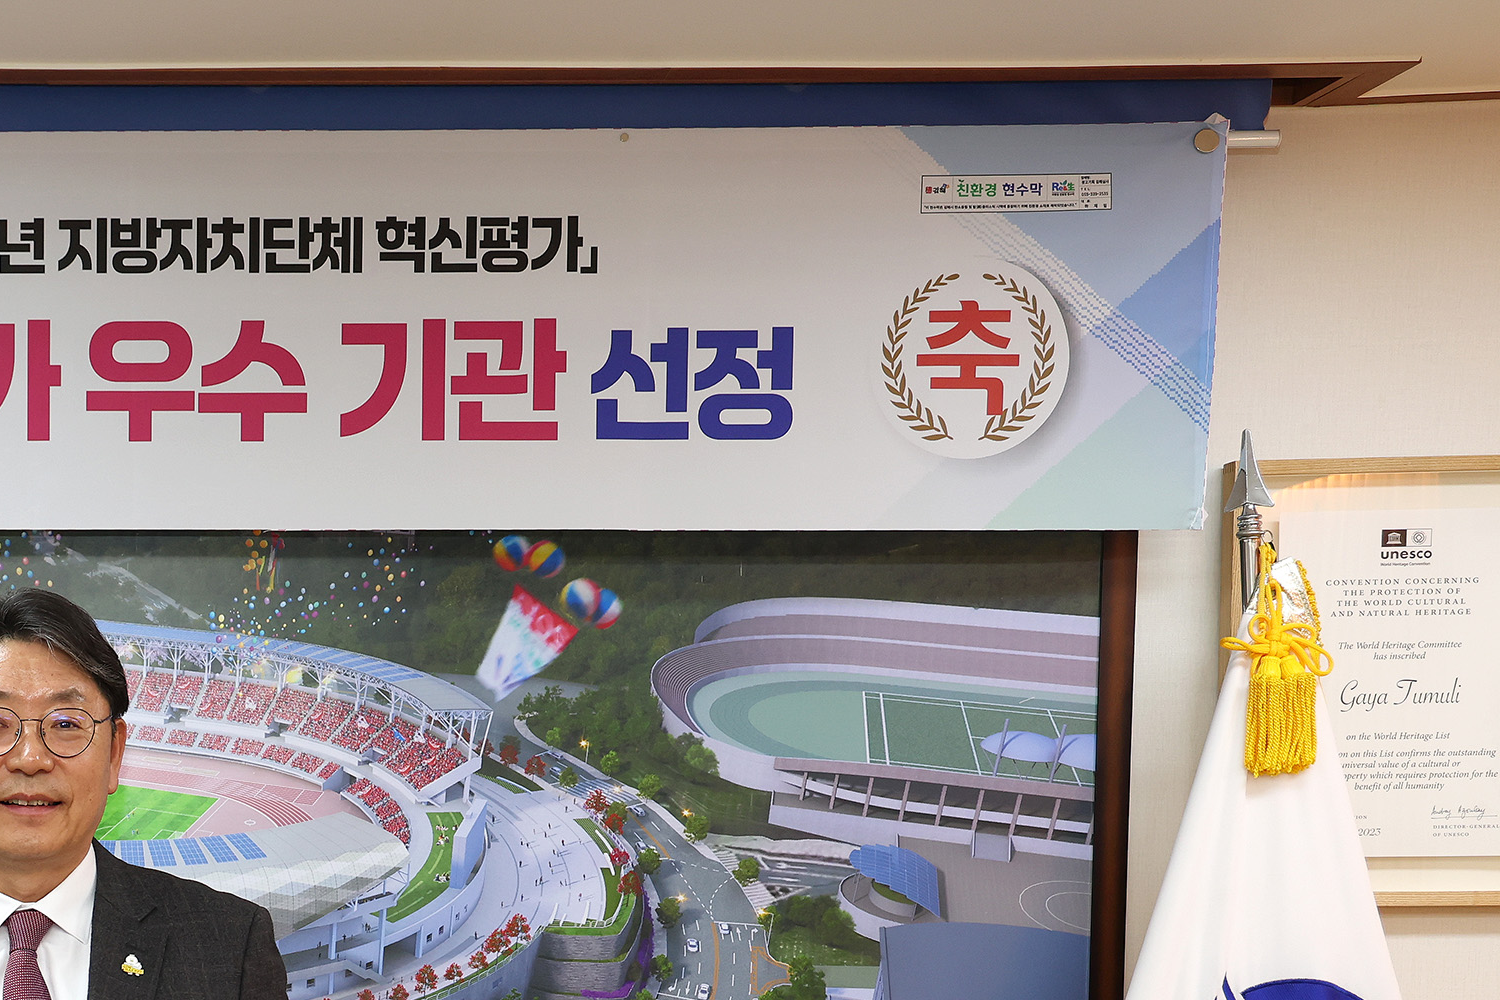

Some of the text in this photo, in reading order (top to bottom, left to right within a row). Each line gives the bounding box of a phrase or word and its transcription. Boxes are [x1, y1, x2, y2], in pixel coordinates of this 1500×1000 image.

[957, 180, 997, 197] 친환경
[1002, 183, 1043, 196] 현수막
[57, 216, 364, 274] 지방자치단체
[375, 215, 599, 275] 혁신평가」
[916, 300, 1020, 415] 축
[85, 319, 308, 442] 우수
[339, 317, 568, 442] 기관
[590, 326, 795, 441] 선정
[1380, 550, 1433, 560] unesco
[1325, 576, 1480, 587] CONVENTION CONCERNING
[1343, 587, 1461, 597] THE PROTECTION OF
[1363, 599, 1403, 607] WORLD
[1407, 598, 1466, 606] CULTURAL
[1330, 608, 1472, 618] AND NATURAL HERITAGE
[1338, 640, 1463, 651] The World Heritage Committee
[1373, 651, 1427, 661] has inscribed
[1340, 676, 1462, 713] Gaya Tumuli
[1358, 732, 1372, 741] the
[1373, 732, 1398, 741] World
[1399, 731, 1434, 742] Heritage
[1435, 731, 1451, 740] List
[1362, 749, 1378, 758] this
[1379, 749, 1394, 758] List
[1395, 748, 1432, 760] confirms
[1433, 749, 1446, 757] the
[1447, 747, 1497, 759] outstanding
[1378, 760, 1400, 769] value
[1400, 759, 1411, 770] of
[1417, 759, 1450, 768] cultural
[1369, 771, 1394, 780] which
[1394, 771, 1428, 782] requires
[1428, 769, 1470, 781] protection
[1470, 769, 1483, 781] for
[1484, 769, 1499, 778] the
[1354, 781, 1446, 793] benefit of all humanity
